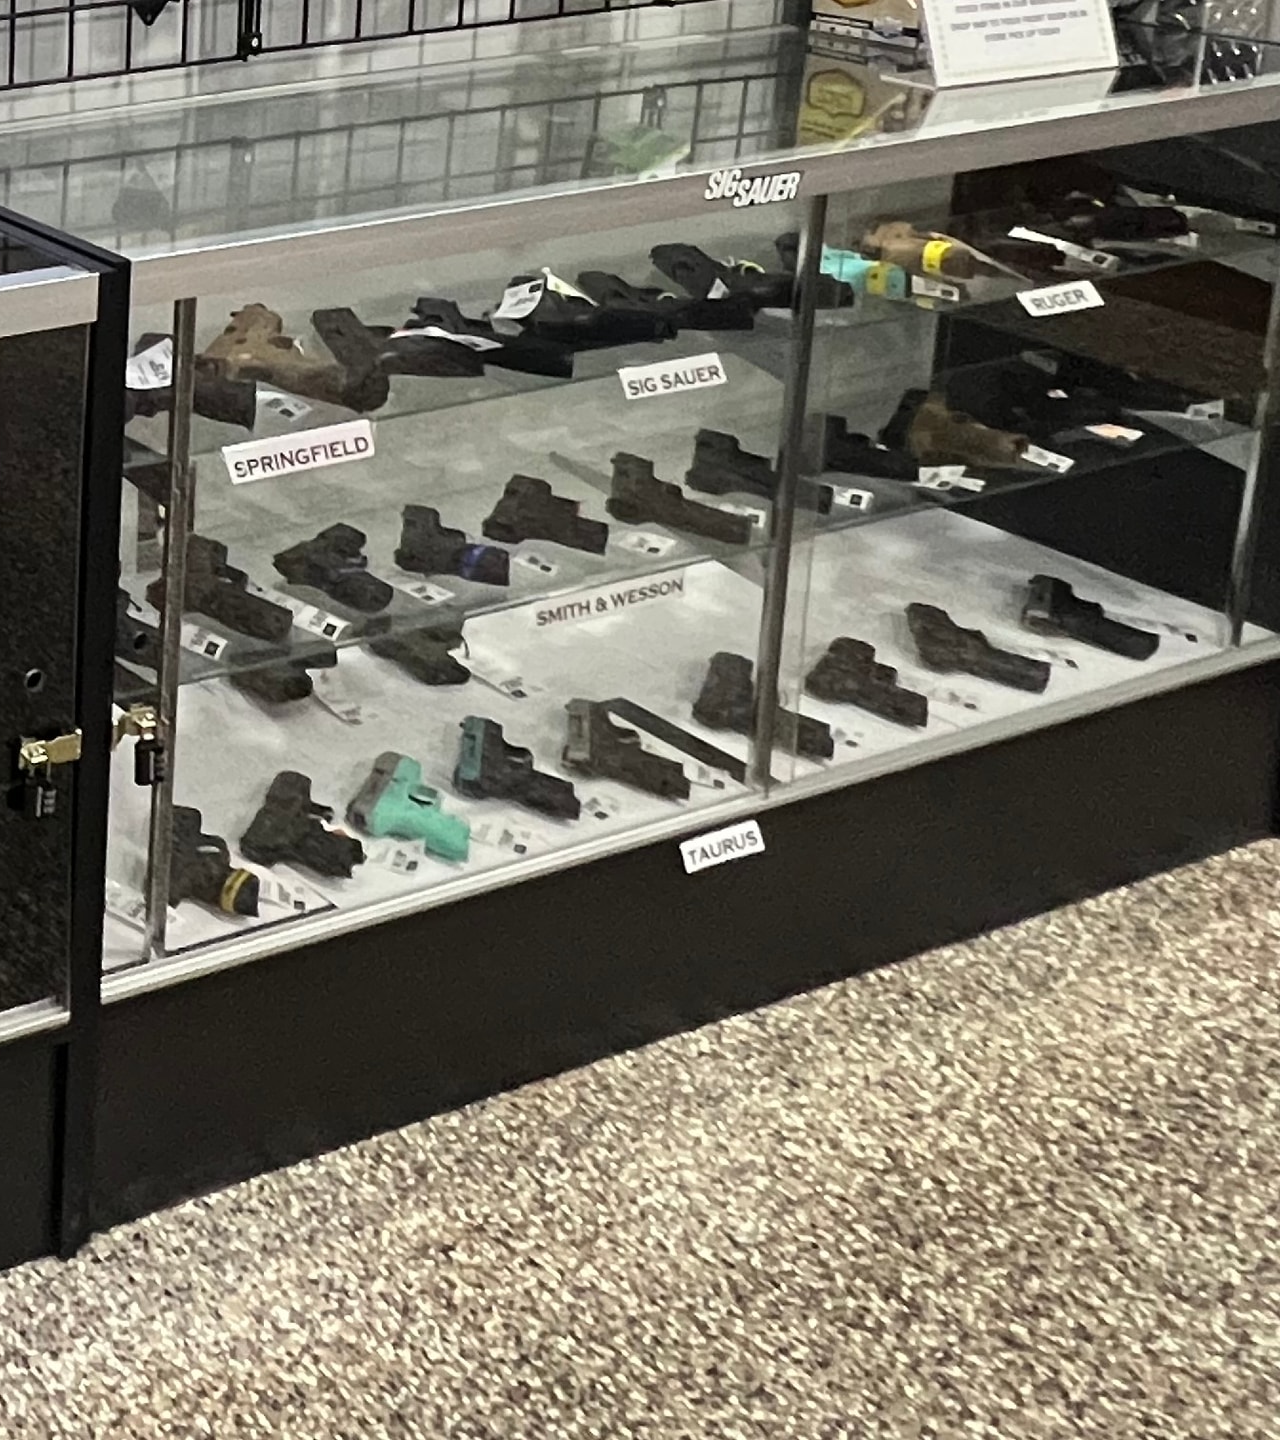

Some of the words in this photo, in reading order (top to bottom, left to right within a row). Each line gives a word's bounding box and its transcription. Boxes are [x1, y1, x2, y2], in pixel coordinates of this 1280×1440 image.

[704, 169, 740, 201] SIG
[734, 172, 801, 207] SAUER
[1030, 286, 1088, 312] RUGER
[628, 377, 658, 396] SIG
[661, 365, 721, 391] SAUER
[234, 435, 370, 479] SPRINGFIELD
[536, 601, 592, 626] SMITH
[594, 596, 609, 613] &
[610, 579, 685, 610] WESSON
[688, 830, 759, 868] TAURUS
